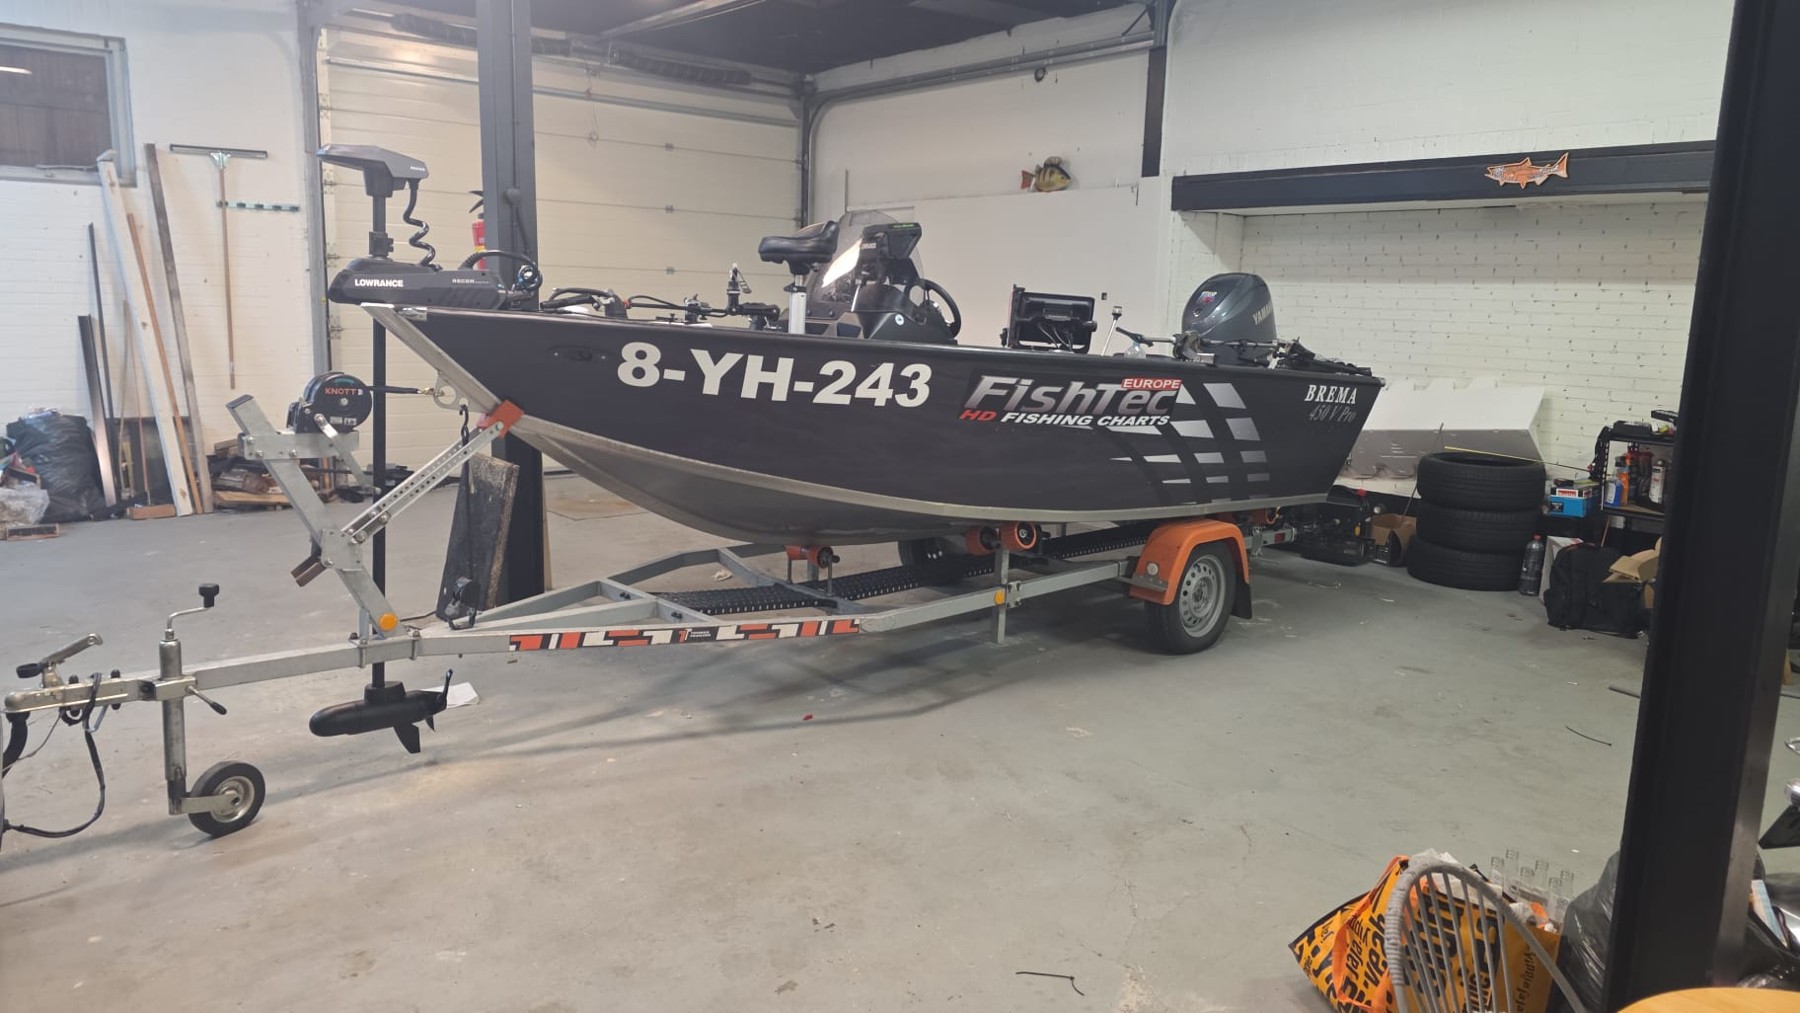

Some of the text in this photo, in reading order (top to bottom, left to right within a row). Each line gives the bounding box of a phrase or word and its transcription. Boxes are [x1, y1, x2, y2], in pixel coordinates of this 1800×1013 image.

[354, 278, 404, 288] LOWRANCE
[1252, 300, 1273, 325] YAMA
[617, 342, 932, 408] 8-YH-243
[1122, 378, 1182, 390] EUROPE
[324, 387, 357, 396] KNOTT
[1304, 384, 1357, 405] BREMA
[959, 409, 1171, 427] HD FISHING CHARTS
